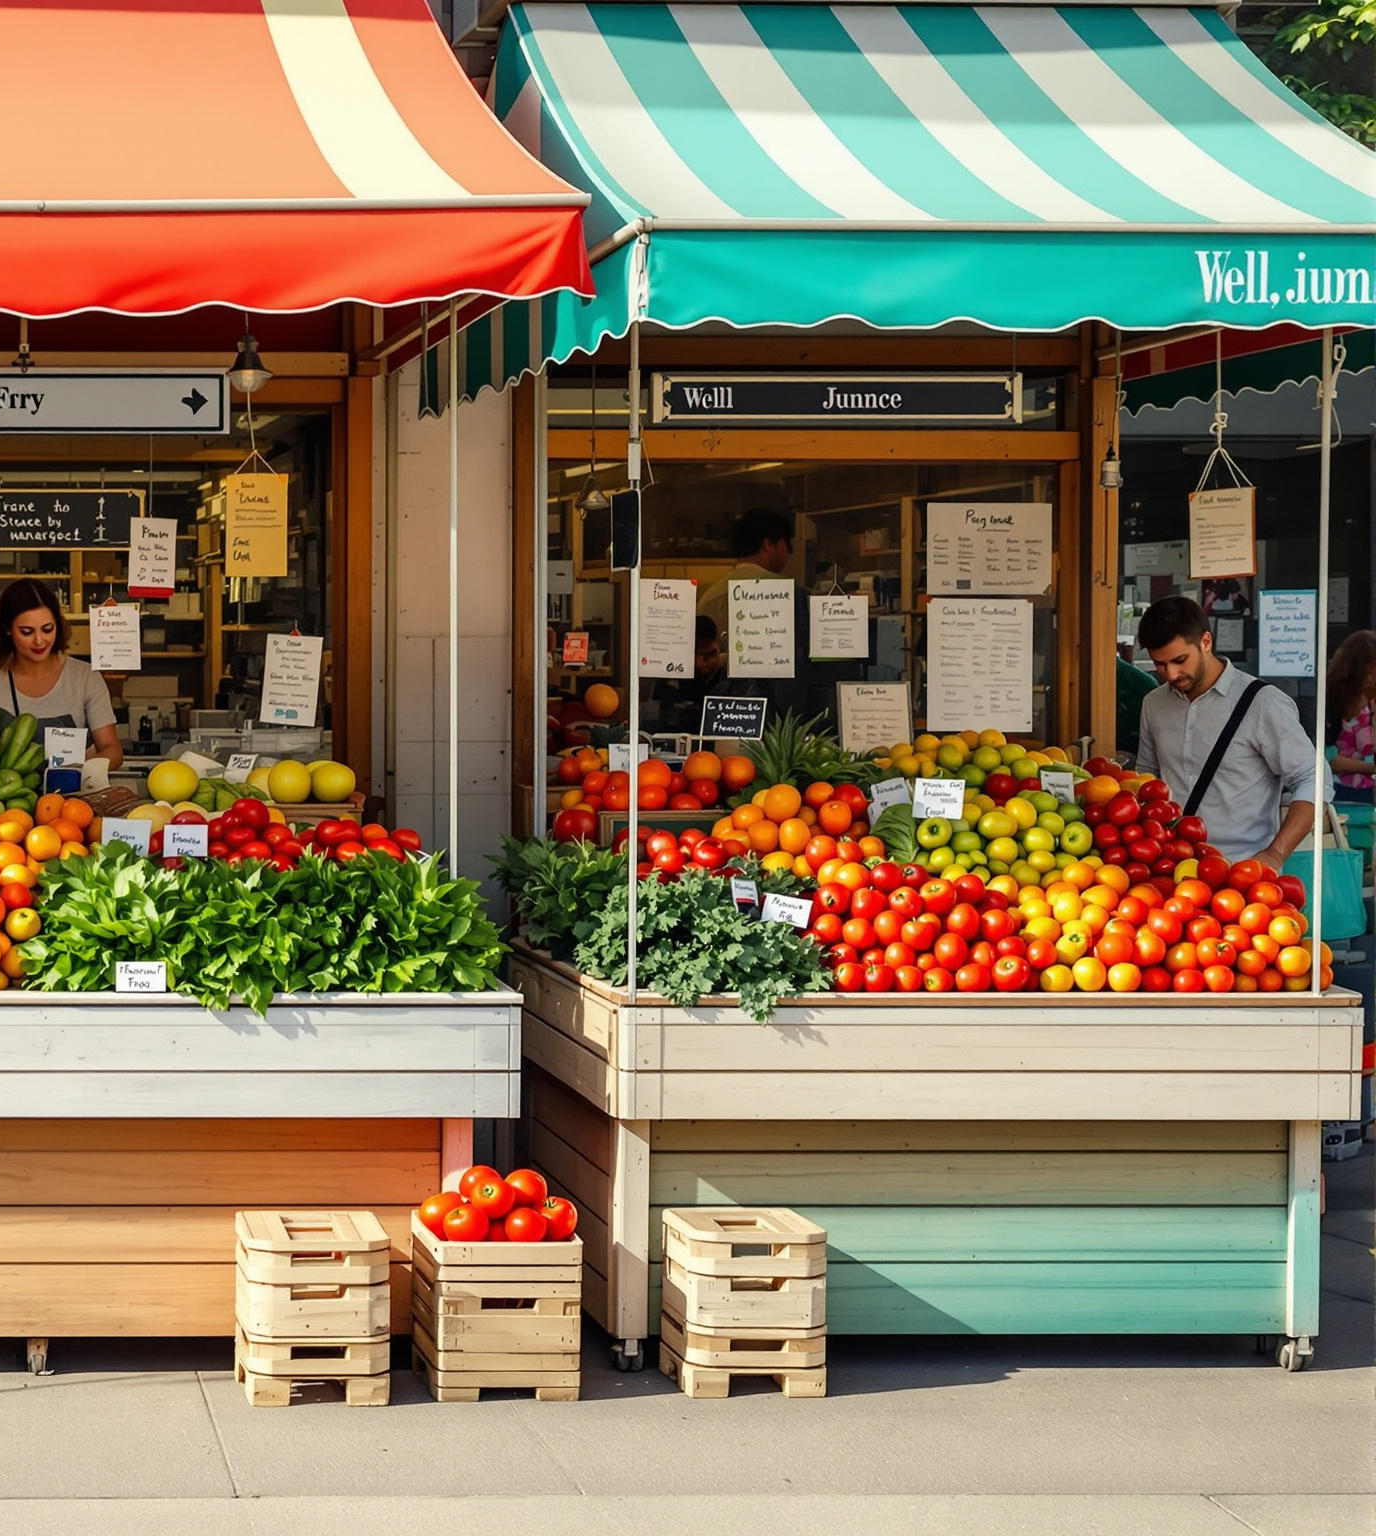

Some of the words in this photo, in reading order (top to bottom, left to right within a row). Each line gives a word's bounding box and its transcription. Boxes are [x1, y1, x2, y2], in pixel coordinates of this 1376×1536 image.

[1194, 250, 1280, 309] Well,
[682, 386, 734, 409] Welll
[822, 387, 902, 410] Junnce
